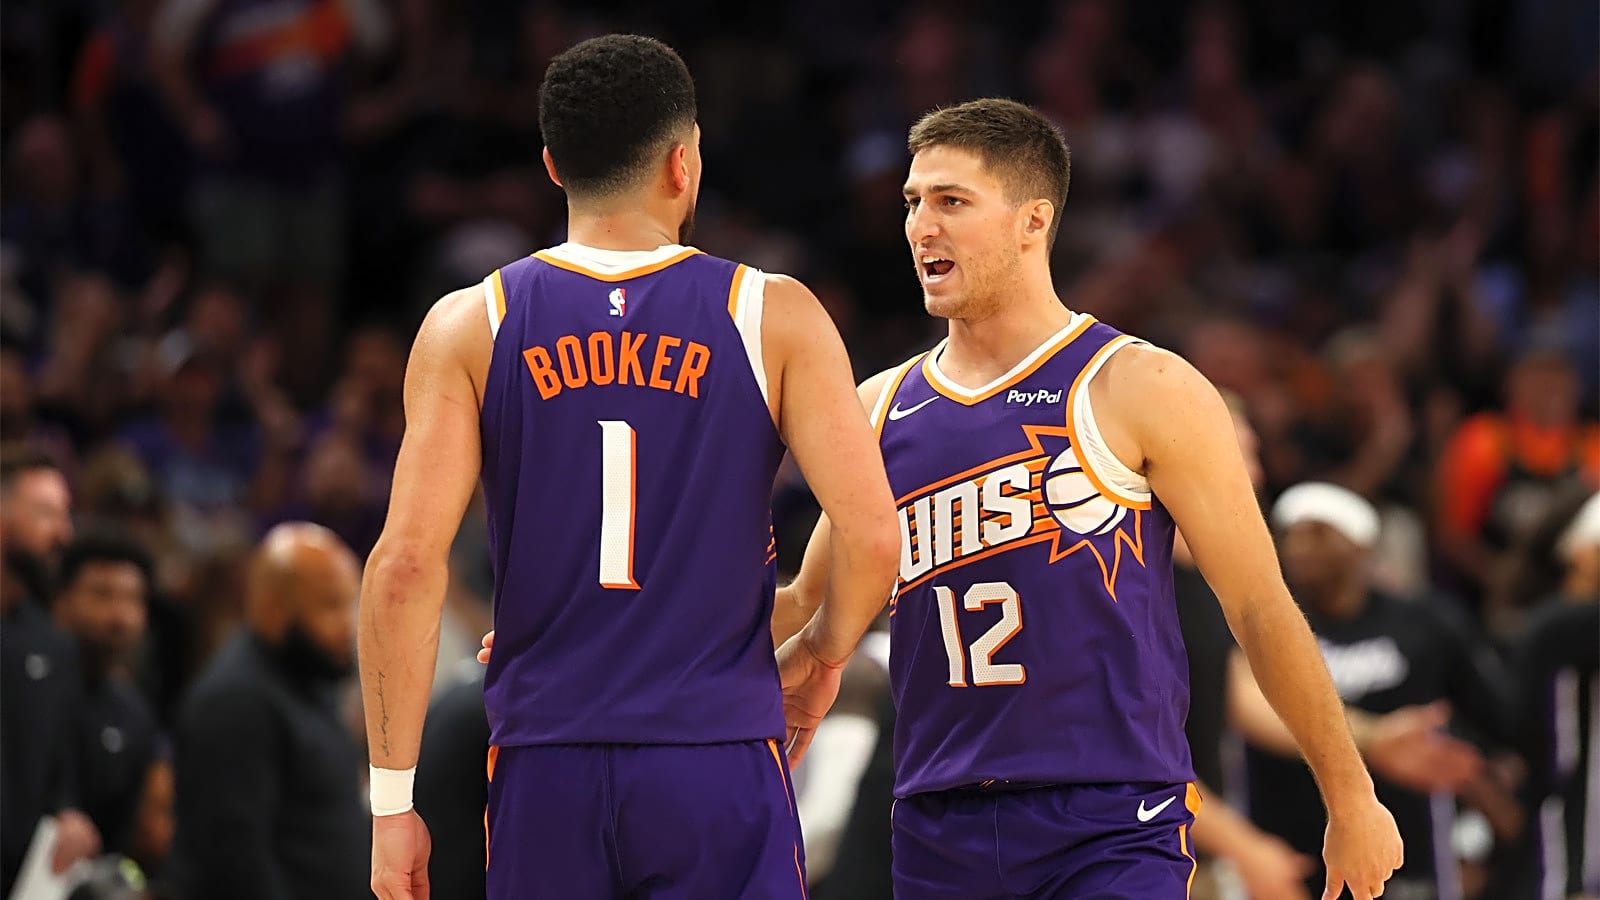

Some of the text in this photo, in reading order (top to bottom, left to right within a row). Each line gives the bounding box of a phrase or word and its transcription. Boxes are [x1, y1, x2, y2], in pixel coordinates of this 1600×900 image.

[522, 331, 711, 400] BOOKER
[1006, 389, 1062, 406] PayPal
[598, 420, 642, 589] 1
[932, 581, 1026, 687] 12
